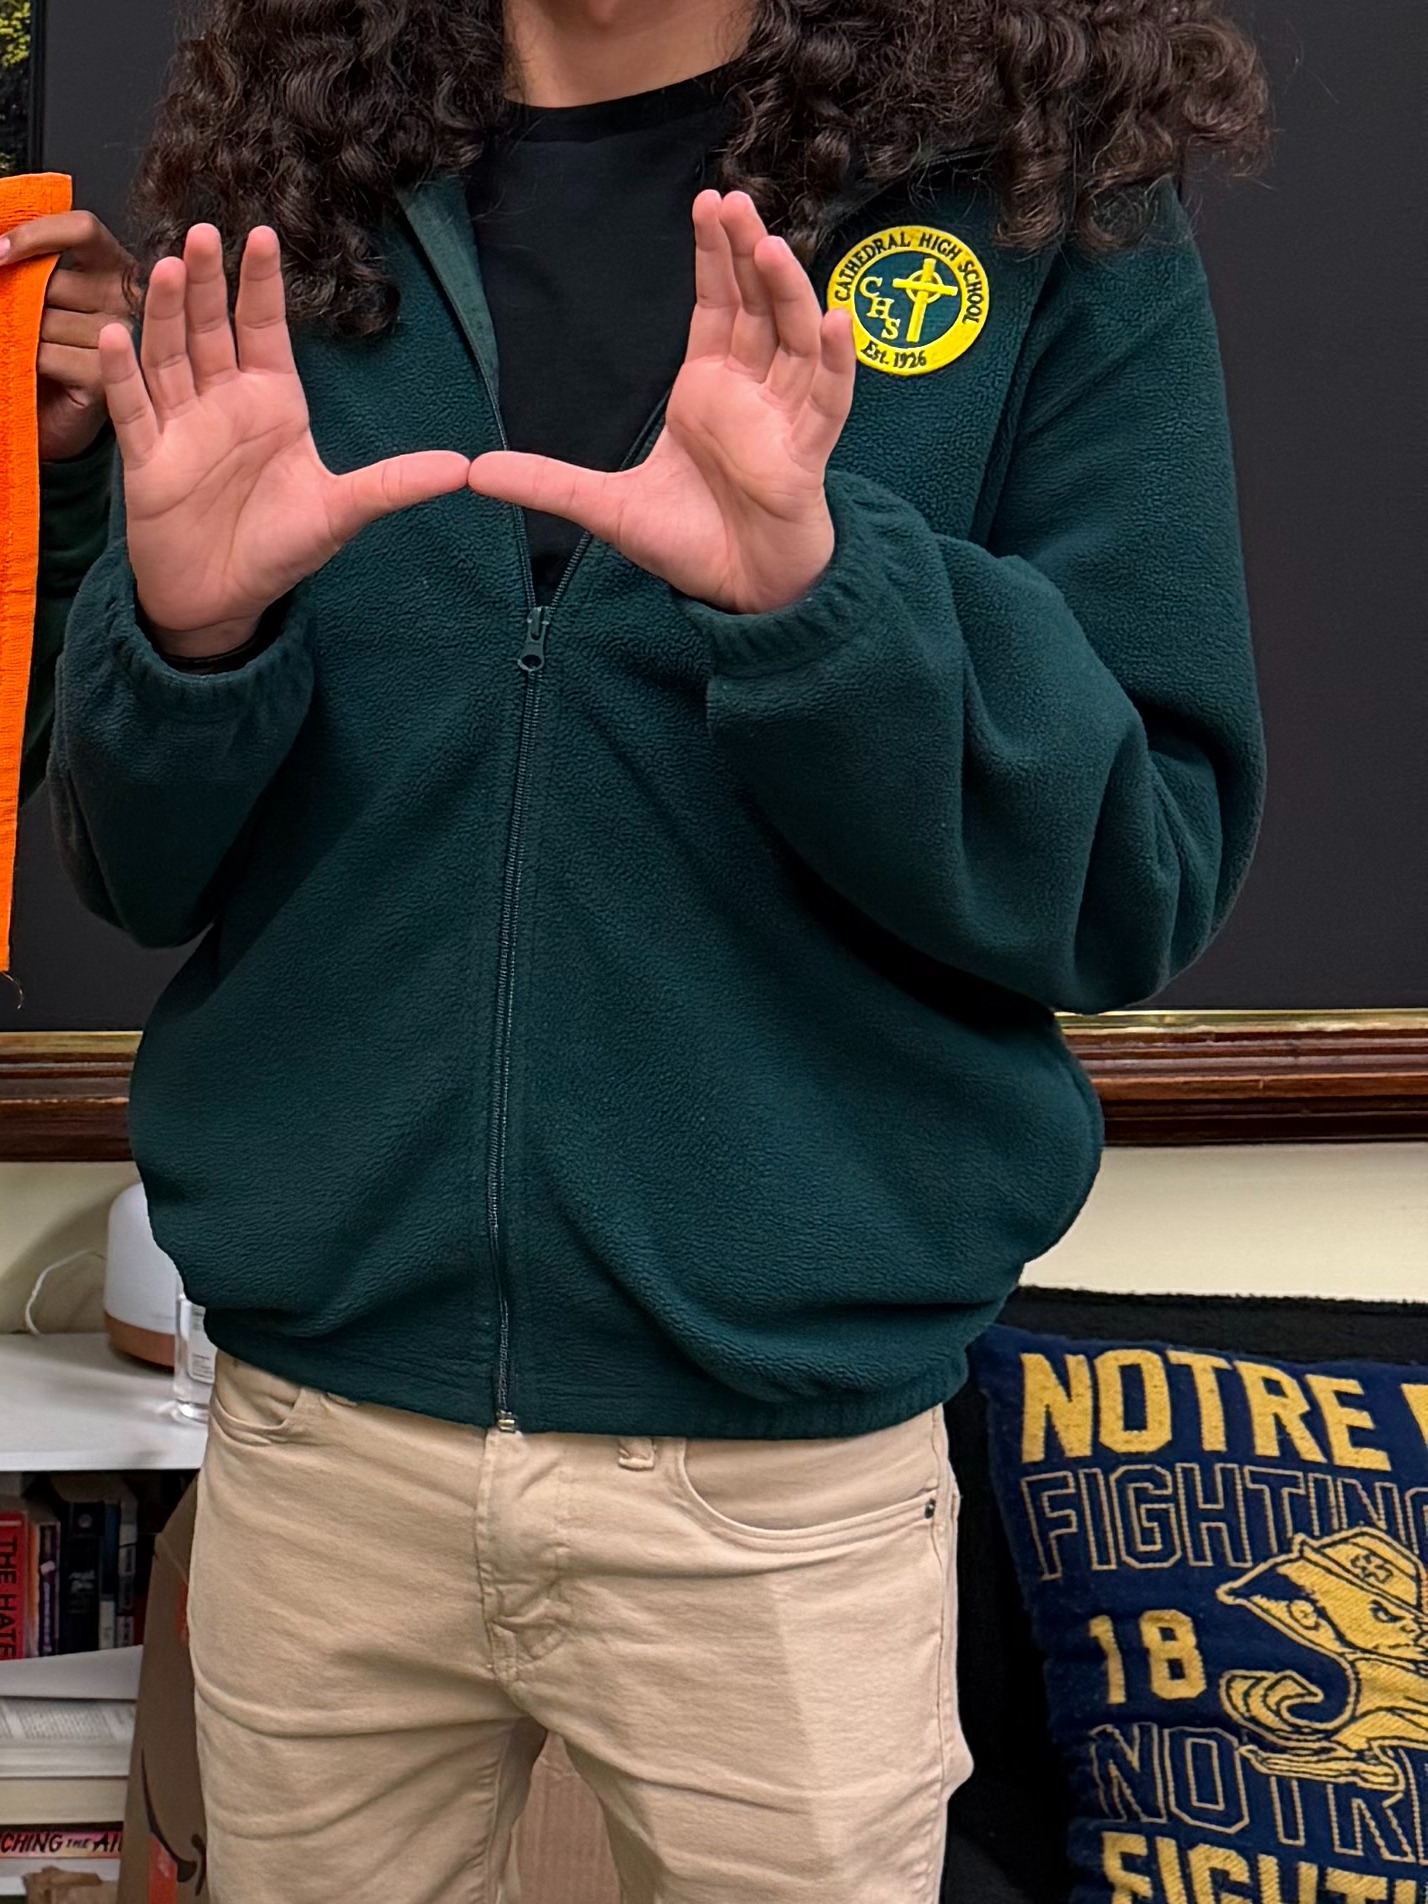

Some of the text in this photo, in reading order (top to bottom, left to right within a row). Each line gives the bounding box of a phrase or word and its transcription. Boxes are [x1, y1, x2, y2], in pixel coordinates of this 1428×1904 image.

[834, 232, 985, 325] CATHEDRAL HIGH SCHOOL
[860, 340, 927, 369] Est. 1926
[1020, 1348, 1392, 1472] NOTRE
[1022, 1463, 1428, 1581] FIGHTIN
[1088, 1722, 1428, 1865] NOR
